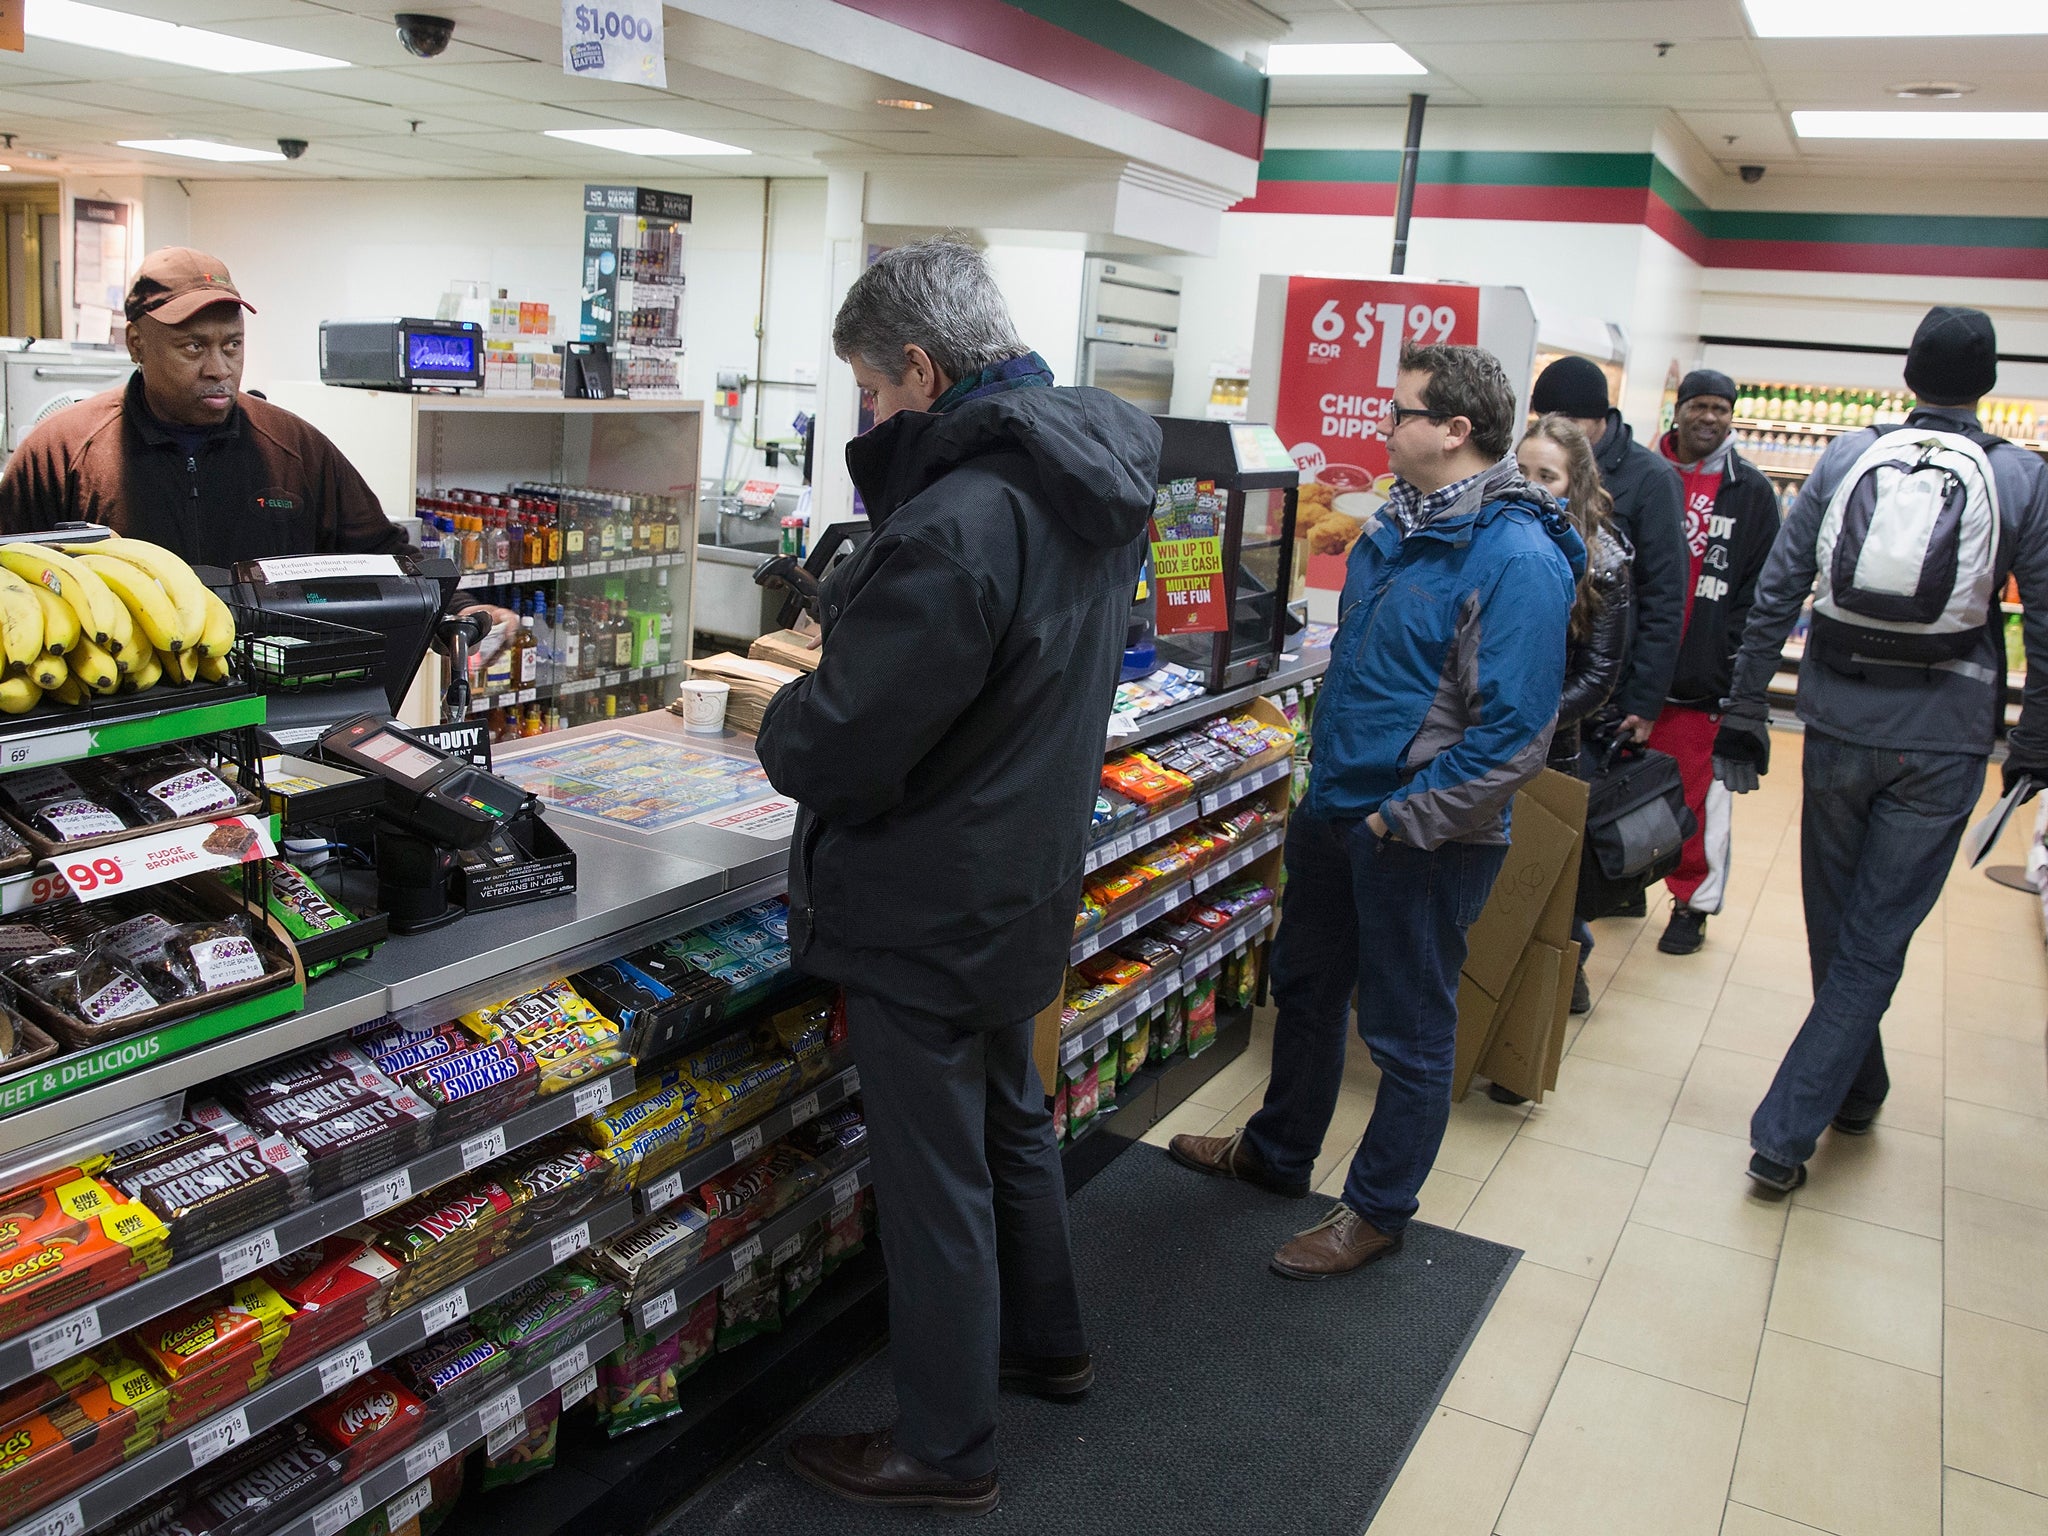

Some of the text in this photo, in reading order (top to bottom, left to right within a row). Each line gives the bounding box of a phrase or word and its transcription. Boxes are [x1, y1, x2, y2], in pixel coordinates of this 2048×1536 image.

[576, 4, 652, 42] $1,000
[663, 201, 688, 210] VAPOR
[1312, 300, 1345, 341] 6
[1308, 343, 1341, 358] FOR
[1157, 541, 1213, 559] WIN UP TO
[281, 561, 312, 570] Refunds
[314, 559, 341, 567] without
[284, 567, 313, 577] Checks
[314, 565, 348, 573] Accepted
[1154, 560, 1179, 575] 100X
[1192, 556, 1220, 571] CASH
[1166, 576, 1211, 592] MULTIPLY
[1167, 589, 1211, 606] THE FUN
[170, 792, 193, 803] FUDGE
[194, 780, 222, 796] BROWNIE
[56, 813, 114, 824] FUDGE BROWNIE
[146, 852, 199, 872] BROWNIE
[147, 845, 184, 862] FUDGE
[480, 882, 528, 898] VETERANS
[530, 881, 539, 889] IN
[541, 875, 564, 886] JOBS
[495, 880, 518, 889] PROFITS
[520, 876, 535, 884] USED
[545, 871, 562, 879] PLACE
[42, 1074, 57, 1091] &
[61, 1036, 161, 1086] DELICIOUS
[428, 1045, 500, 1085] SNICKERS
[445, 1057, 518, 1100] SNICKERS
[260, 1077, 362, 1126] HERSHEY'S
[197, 1105, 222, 1119] KING
[199, 1112, 224, 1125] SIZE
[298, 1099, 399, 1149] HERSHEY'S
[233, 1134, 257, 1149] KING
[336, 1123, 389, 1148] MILK CHOCOLATE
[130, 1144, 164, 1162] CHOCOLATE
[173, 1131, 201, 1145] ALMONDS
[264, 1143, 288, 1157] KING
[269, 1150, 292, 1164] SIZE
[153, 1149, 268, 1209] HERSHEY'S
[71, 1190, 99, 1205] KING
[187, 1200, 202, 1211] MILK
[202, 1187, 236, 1206] CHOCOLATE
[244, 1173, 271, 1189] ALMONDS
[75, 1198, 102, 1212] SIZE
[114, 1214, 141, 1230] KING
[119, 1222, 146, 1237] SIZE
[612, 1216, 678, 1260] HERSHEY'S
[160, 1314, 215, 1352] Reese's
[195, 1328, 216, 1345] CUP
[430, 1341, 495, 1388] SNICKERS
[122, 1373, 149, 1393] KING
[126, 1382, 153, 1400] SIZE
[342, 1393, 394, 1434] Kit Kat
[208, 1437, 328, 1519] HERSHEY'S
[273, 1472, 318, 1501] CHOCOLATE
